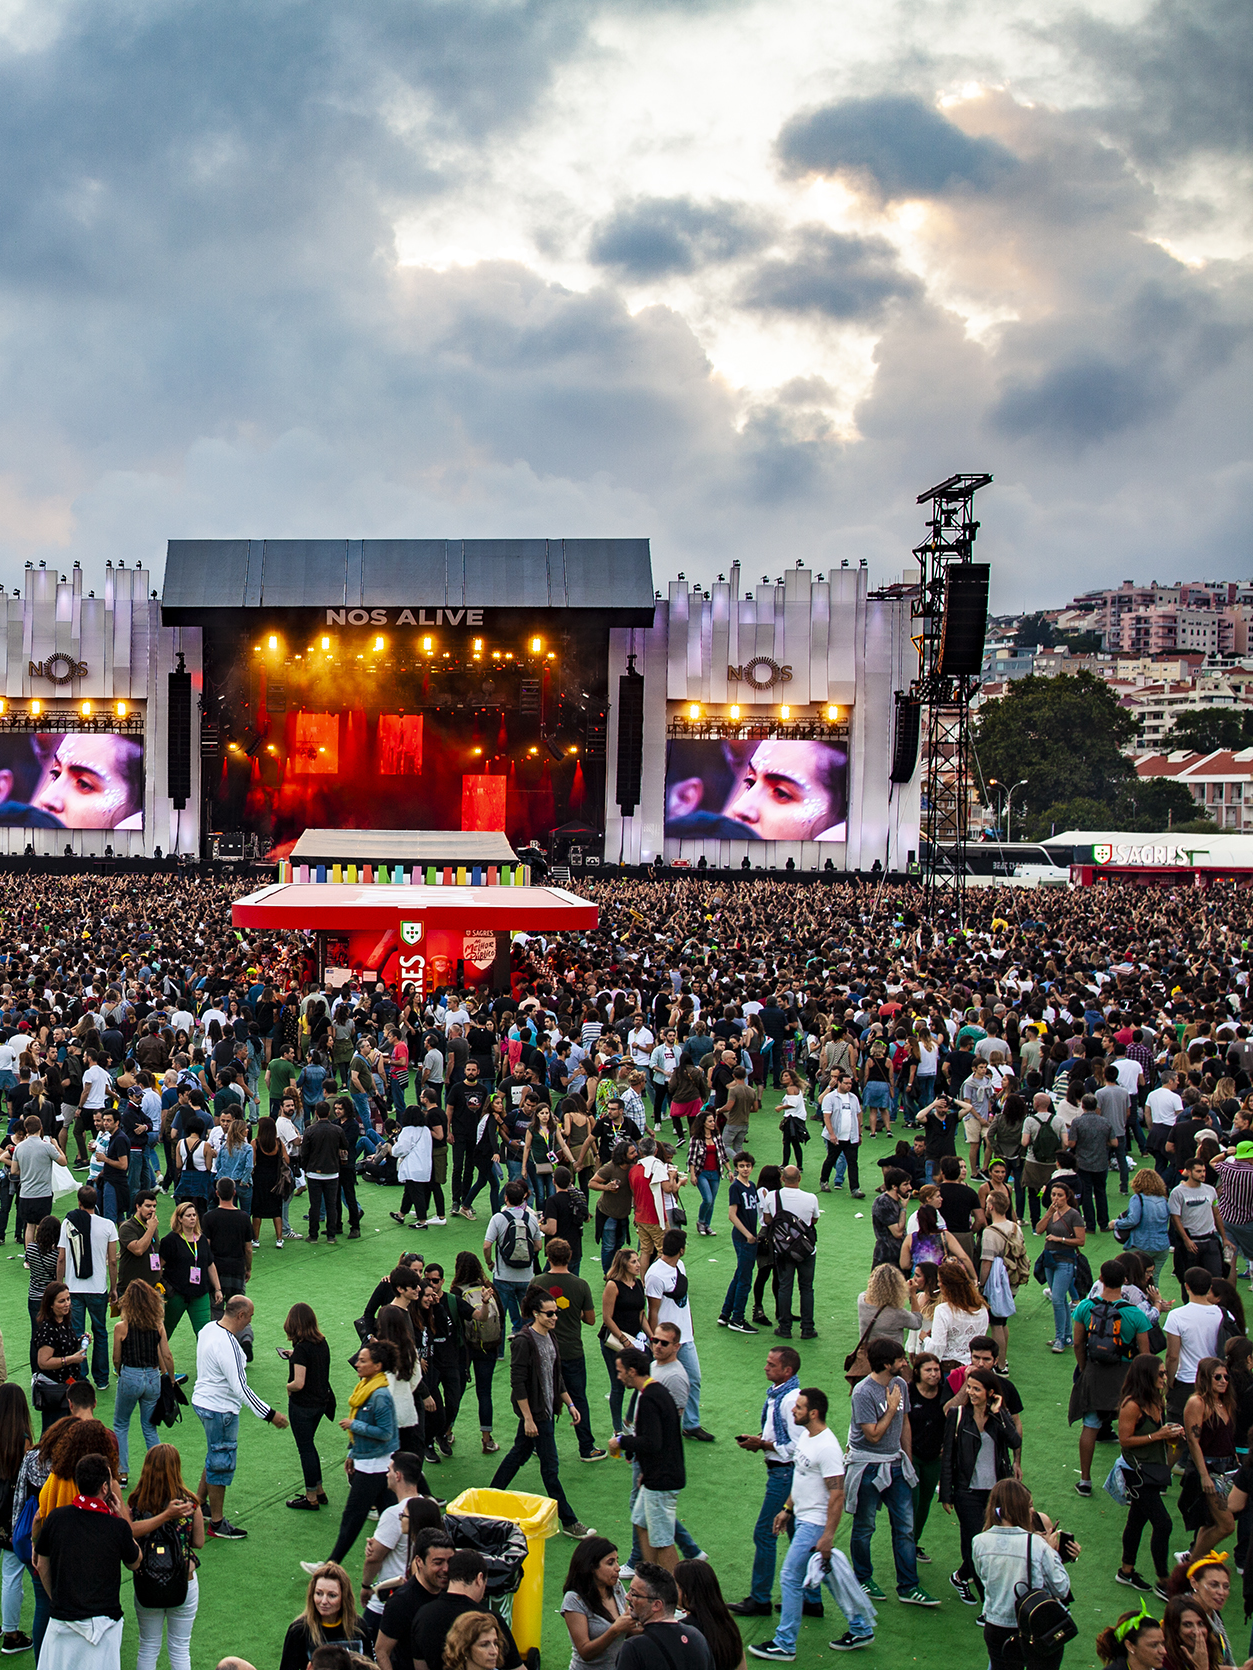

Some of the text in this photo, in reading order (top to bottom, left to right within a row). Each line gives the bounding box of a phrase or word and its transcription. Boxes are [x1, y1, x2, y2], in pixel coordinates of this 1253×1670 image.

[326, 609, 484, 626] NOS ALIVE
[28, 653, 89, 685] NOS
[727, 656, 793, 690] NOS
[1116, 844, 1188, 867] SAGRES
[472, 929, 494, 937] SAGRES
